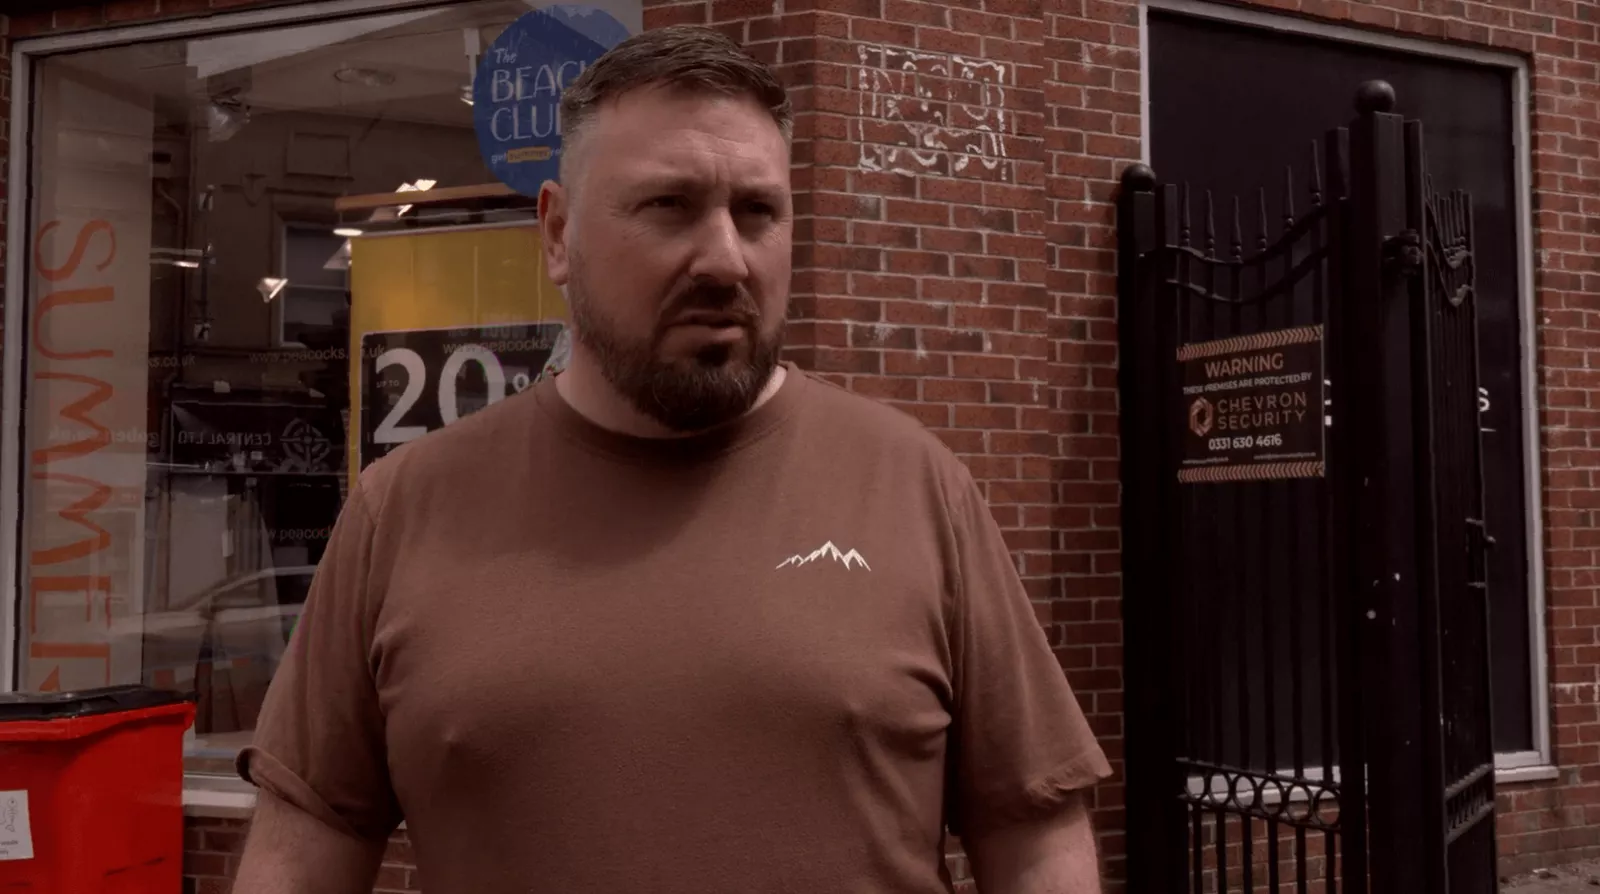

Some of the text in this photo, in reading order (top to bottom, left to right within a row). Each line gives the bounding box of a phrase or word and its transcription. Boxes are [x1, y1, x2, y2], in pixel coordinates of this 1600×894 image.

[494, 48, 517, 64] The
[1204, 352, 1284, 378] WARNING
[1204, 379, 1238, 392] PREMISES
[1239, 378, 1253, 388] ARE
[1254, 374, 1300, 386] PROTECTED
[1300, 371, 1312, 381] BY
[1217, 391, 1307, 413] CHEVRON
[1217, 409, 1306, 430] SECURITY
[1208, 433, 1283, 450] 0331 630 4616
